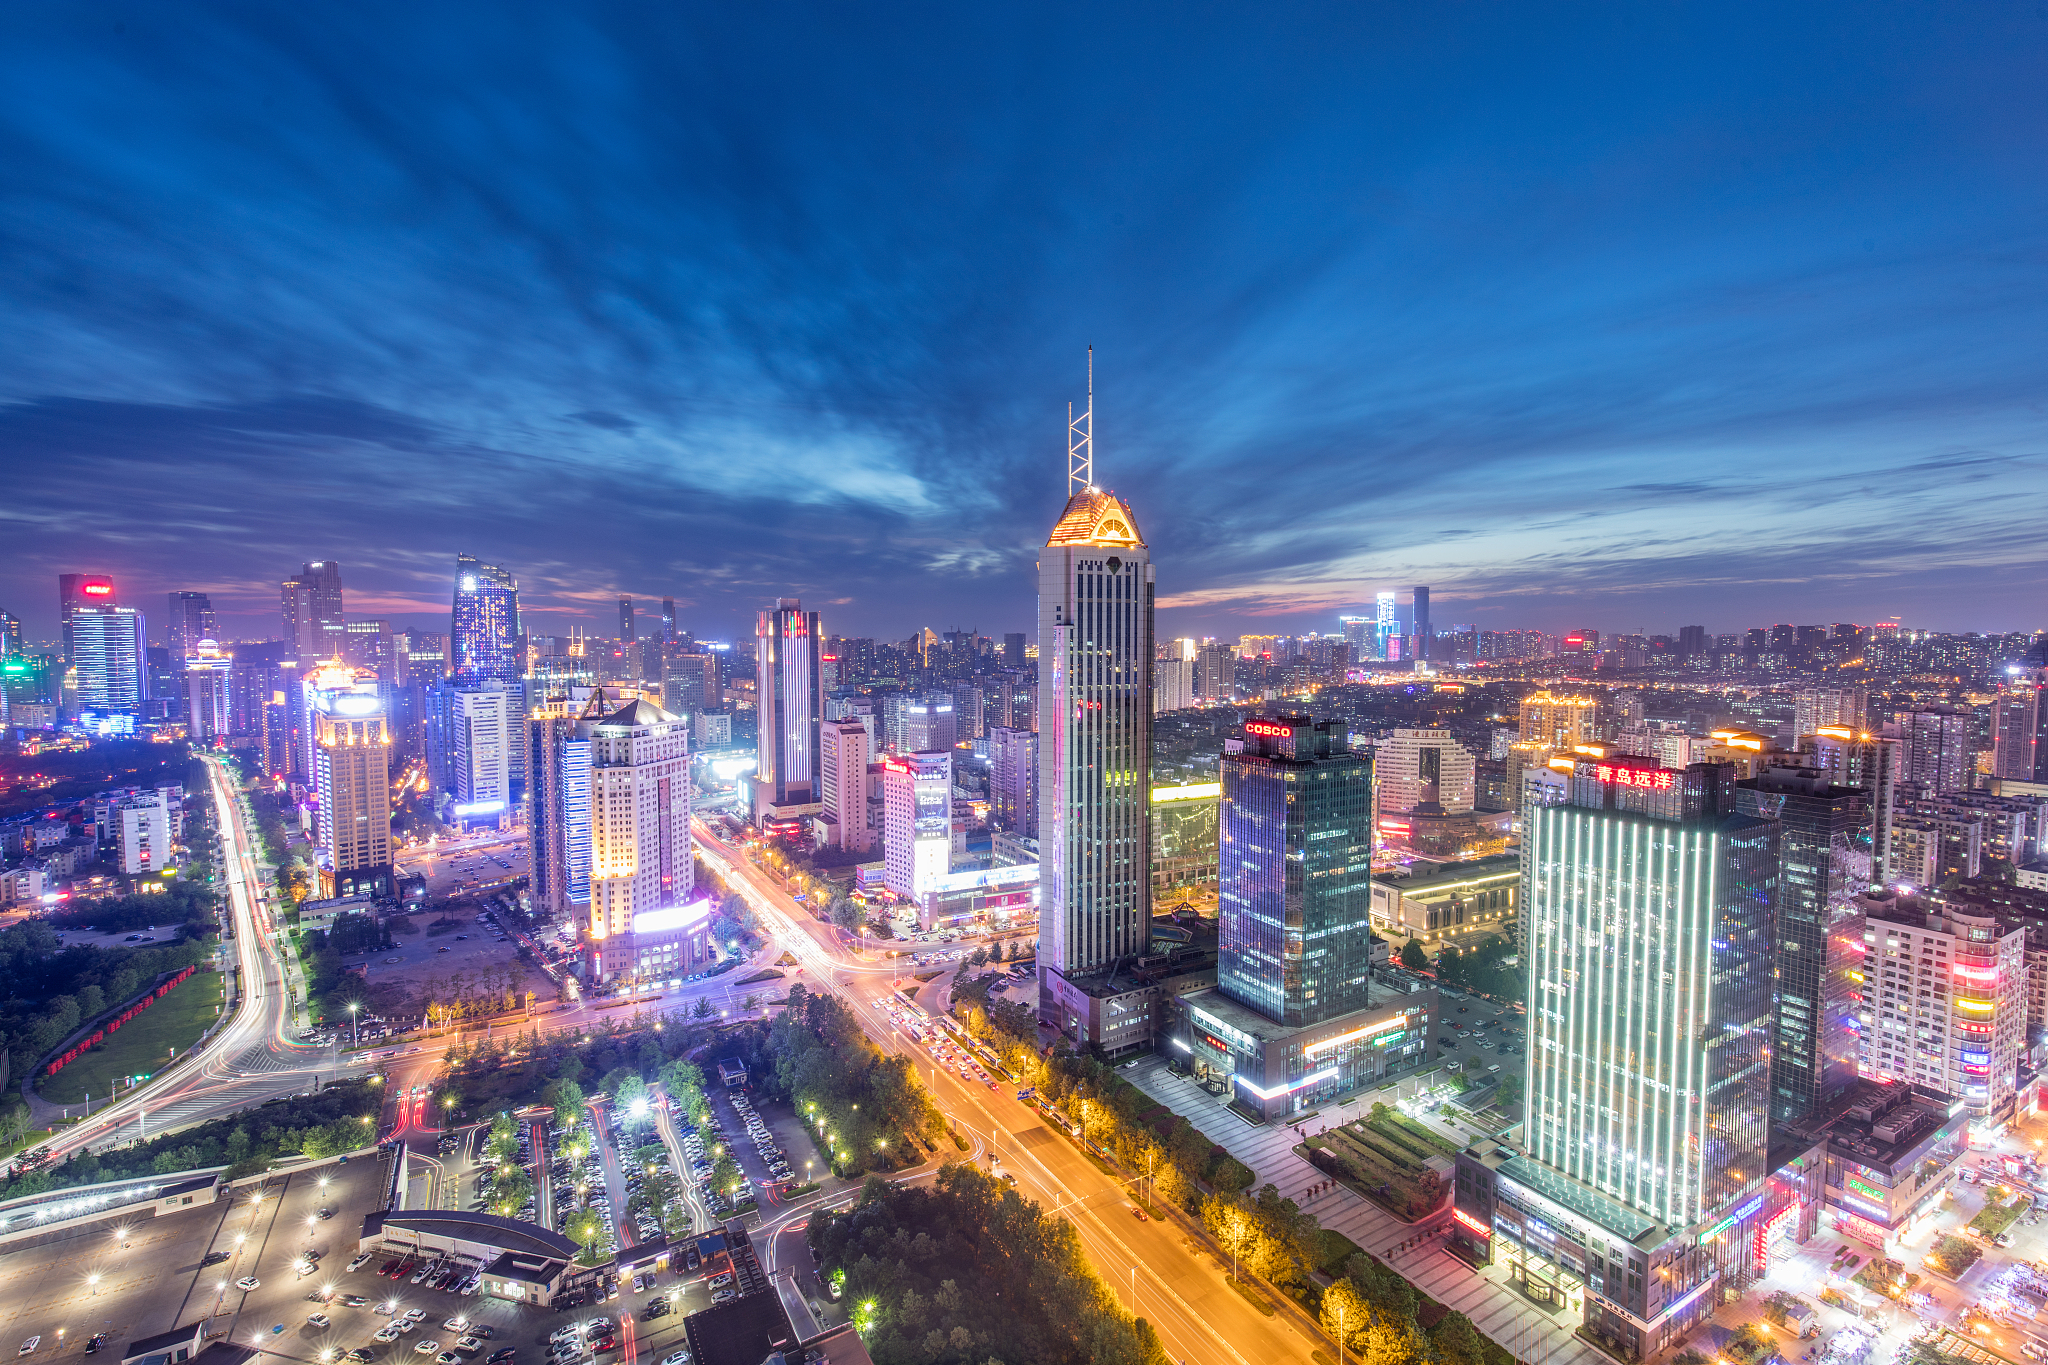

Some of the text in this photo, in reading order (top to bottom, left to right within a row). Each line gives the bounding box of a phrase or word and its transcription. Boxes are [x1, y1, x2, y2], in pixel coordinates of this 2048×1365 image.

[1246, 723, 1291, 737] COSCO
[1597, 766, 1671, 789] 青岛远洋
